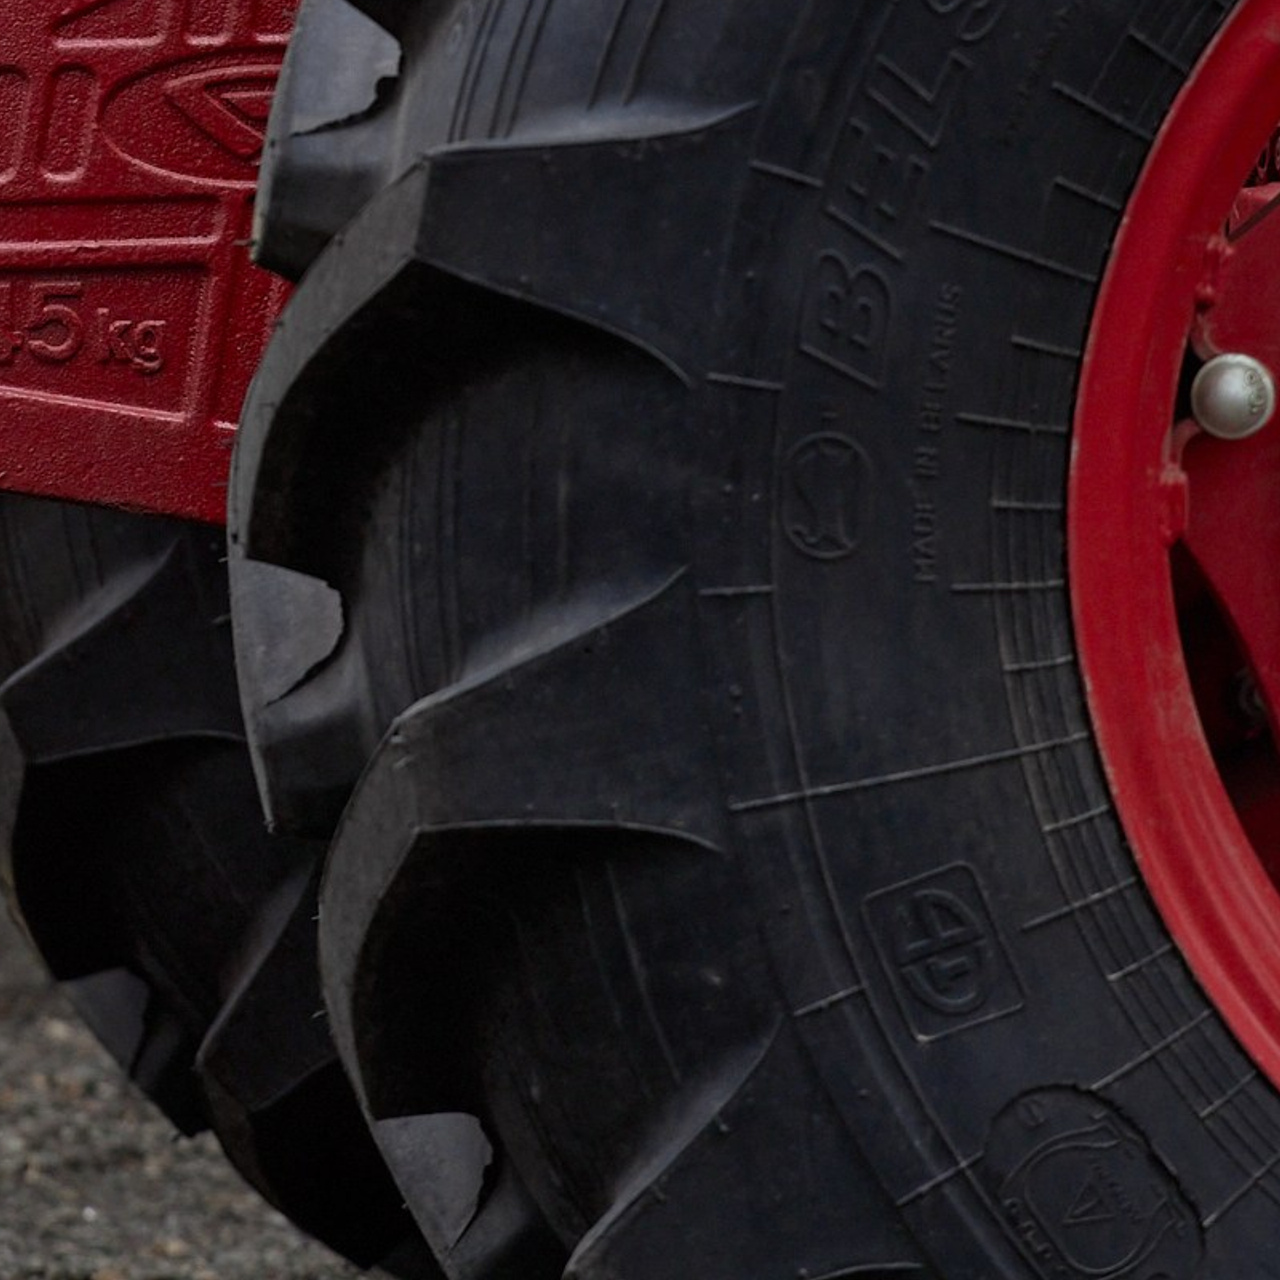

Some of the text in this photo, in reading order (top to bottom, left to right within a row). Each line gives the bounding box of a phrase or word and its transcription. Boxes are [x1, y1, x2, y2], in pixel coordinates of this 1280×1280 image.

[95, 306, 168, 376] kg
[918, 281, 964, 434] BELARUS
[914, 442, 940, 480] IN
